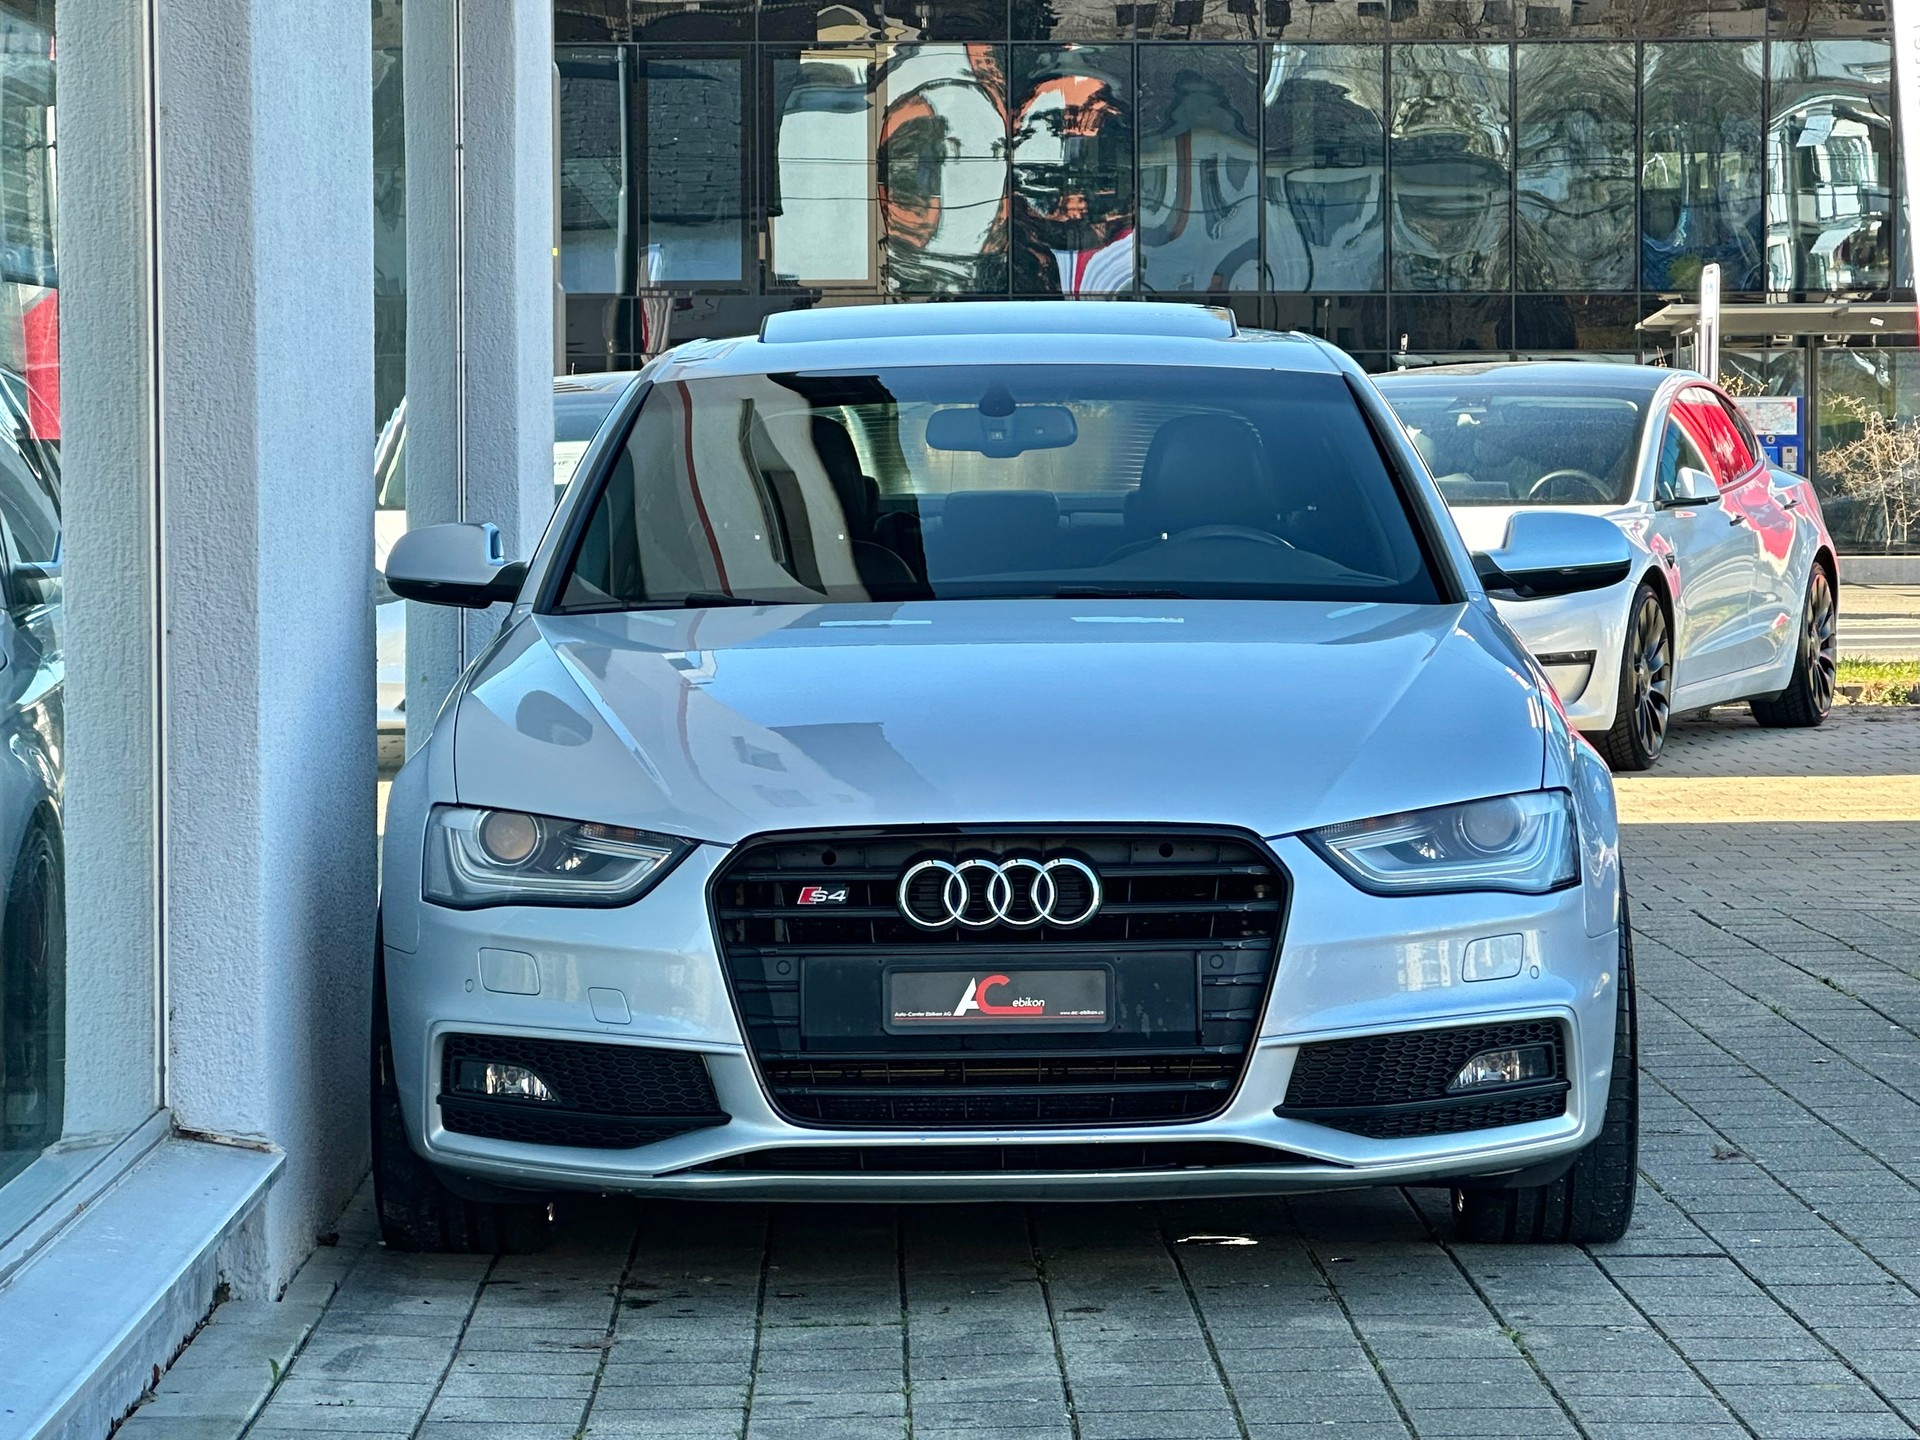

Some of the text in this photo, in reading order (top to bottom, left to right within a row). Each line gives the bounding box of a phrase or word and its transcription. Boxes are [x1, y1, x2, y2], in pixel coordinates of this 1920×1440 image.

[807, 889, 847, 902] S4
[953, 974, 1042, 1017] AC
[1012, 997, 1045, 1007] ebikon
